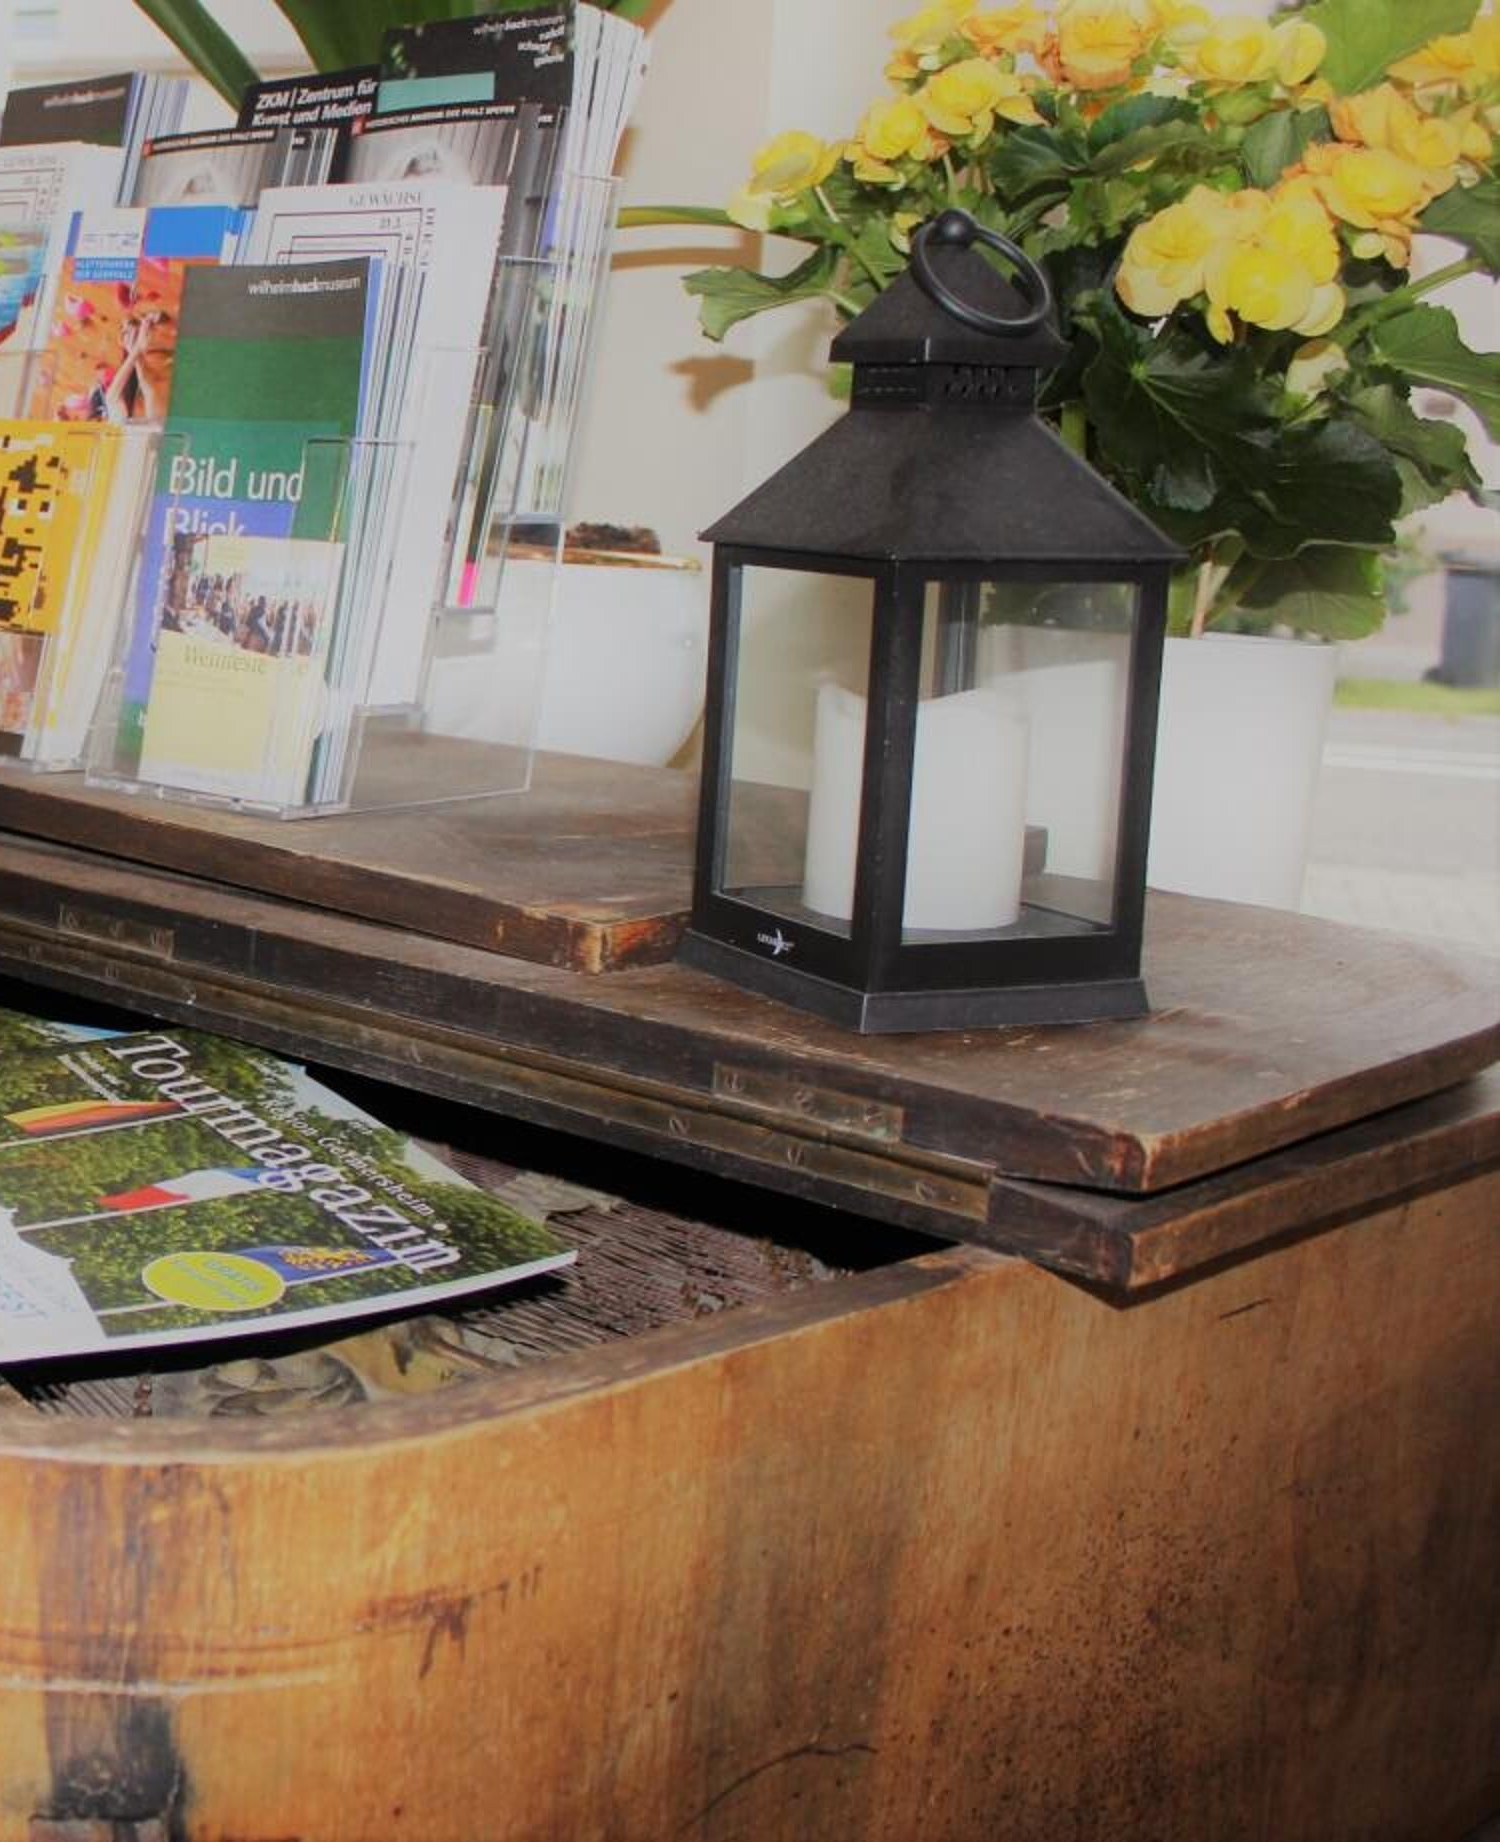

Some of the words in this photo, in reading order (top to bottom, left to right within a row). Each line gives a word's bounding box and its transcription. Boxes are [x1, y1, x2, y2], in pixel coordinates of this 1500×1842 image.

[255, 91, 289, 110] ZKM
[297, 85, 355, 105] Zentrum
[357, 79, 378, 96] für
[293, 106, 320, 124] und
[322, 99, 373, 120] Medien
[169, 455, 238, 499] Bild
[247, 460, 306, 502] und
[104, 1033, 462, 1275] Tourmagazin
